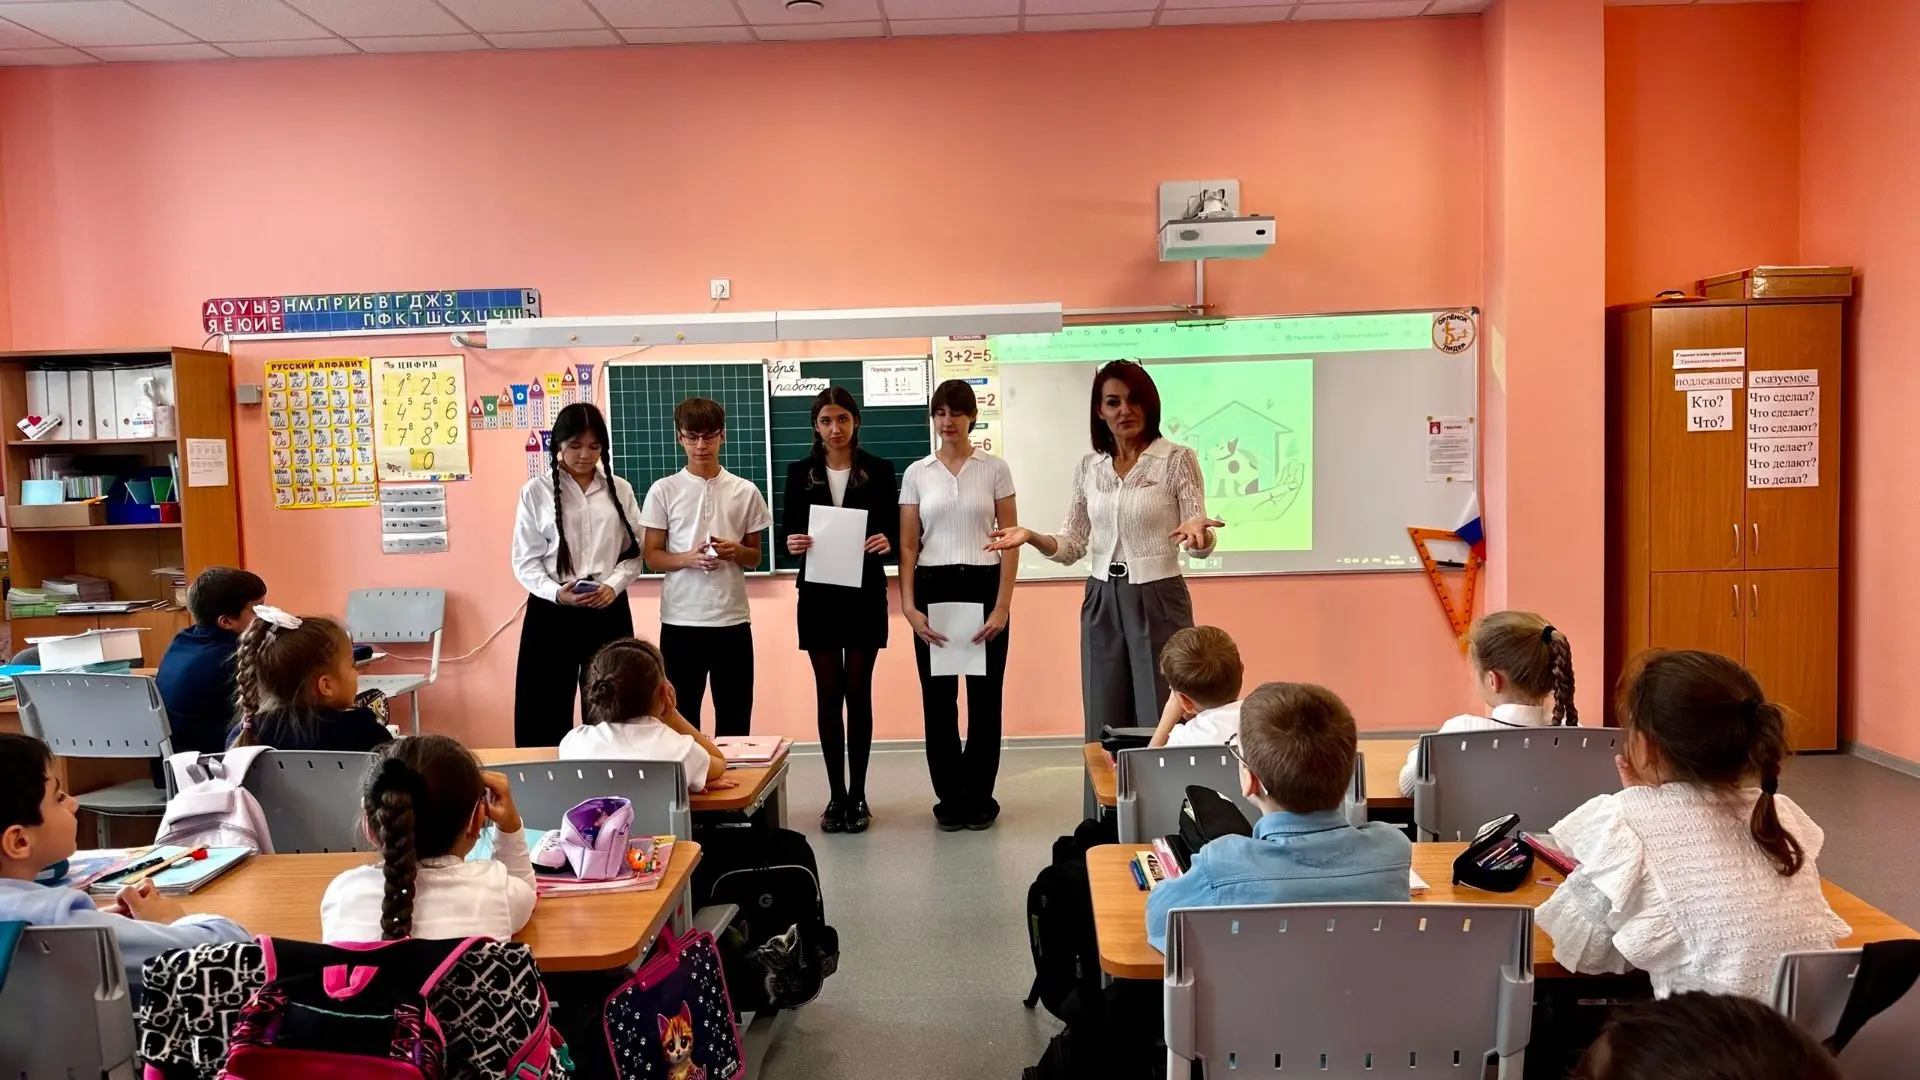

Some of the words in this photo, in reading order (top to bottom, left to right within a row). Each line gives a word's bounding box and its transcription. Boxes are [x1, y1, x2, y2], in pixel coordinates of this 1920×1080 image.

[1438, 314, 1468, 325] ОРЛЁНОК
[1442, 343, 1466, 352] ЛИДЕР
[944, 349, 992, 363] 3+2=5
[318, 360, 362, 368] АЛФАВИТ
[398, 361, 438, 370] ЦИФРЫ
[1676, 377, 1742, 386] подлежащее
[1755, 375, 1810, 385] сказуемое
[398, 378, 406, 396] 1
[420, 378, 431, 396] 2
[445, 376, 456, 395] 3
[1692, 395, 1724, 408] Кто?
[1750, 393, 1770, 402] Что
[1774, 391, 1814, 402] сделал?
[397, 403, 406, 421] 4
[420, 402, 432, 420] 5
[446, 402, 457, 420] 6
[1750, 409, 1769, 417] Что
[1772, 407, 1814, 418] сделает?
[1693, 416, 1724, 428] Что?
[1750, 424, 1768, 433] Что
[1771, 423, 1817, 433] сделают?
[398, 427, 407, 446] 7
[421, 427, 432, 446] 8
[447, 426, 458, 444] 9
[1750, 443, 1770, 452] Что
[1773, 441, 1813, 453] делает?
[424, 452, 434, 470] 0
[1750, 459, 1769, 469] Что
[1773, 457, 1816, 469] делают?
[1750, 475, 1769, 485] Что
[1772, 474, 1808, 485] делал?
